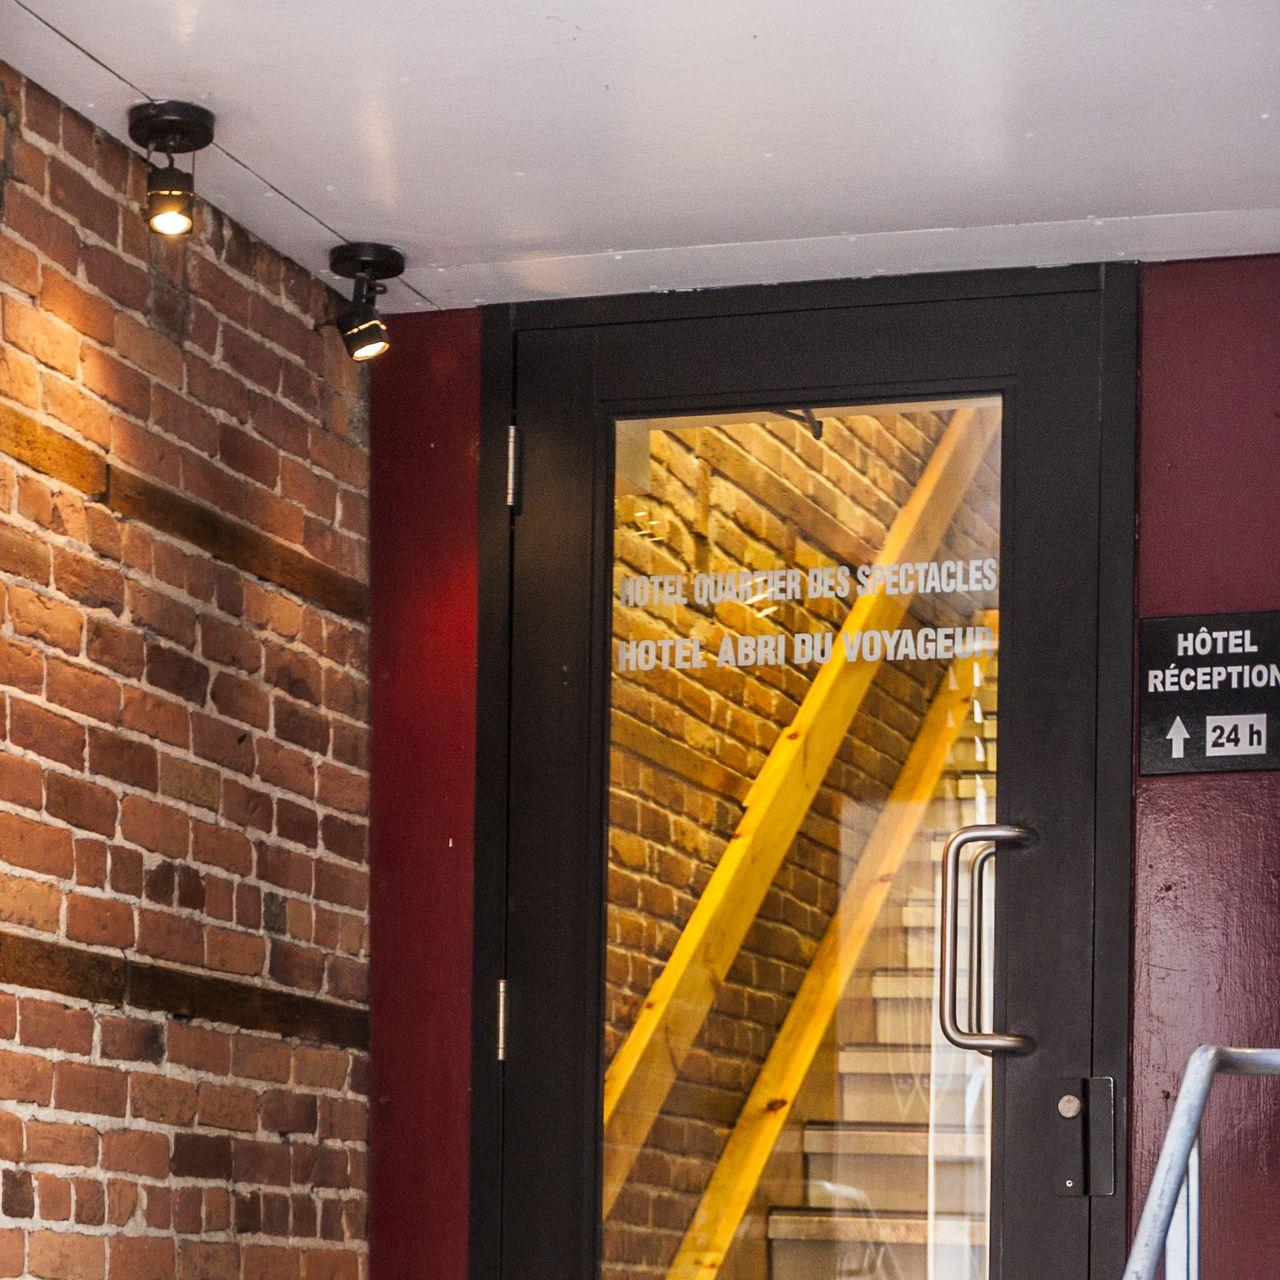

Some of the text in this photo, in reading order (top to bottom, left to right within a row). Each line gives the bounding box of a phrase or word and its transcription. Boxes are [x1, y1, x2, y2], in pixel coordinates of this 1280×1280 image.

[620, 558, 998, 607] HOTEL QUARTIER DES SPECTACLES
[618, 626, 995, 672] HOTEL ABRI DU VOYAGEUR
[1177, 627, 1258, 656] HÔTEL
[1211, 723, 1262, 748] 24 h
